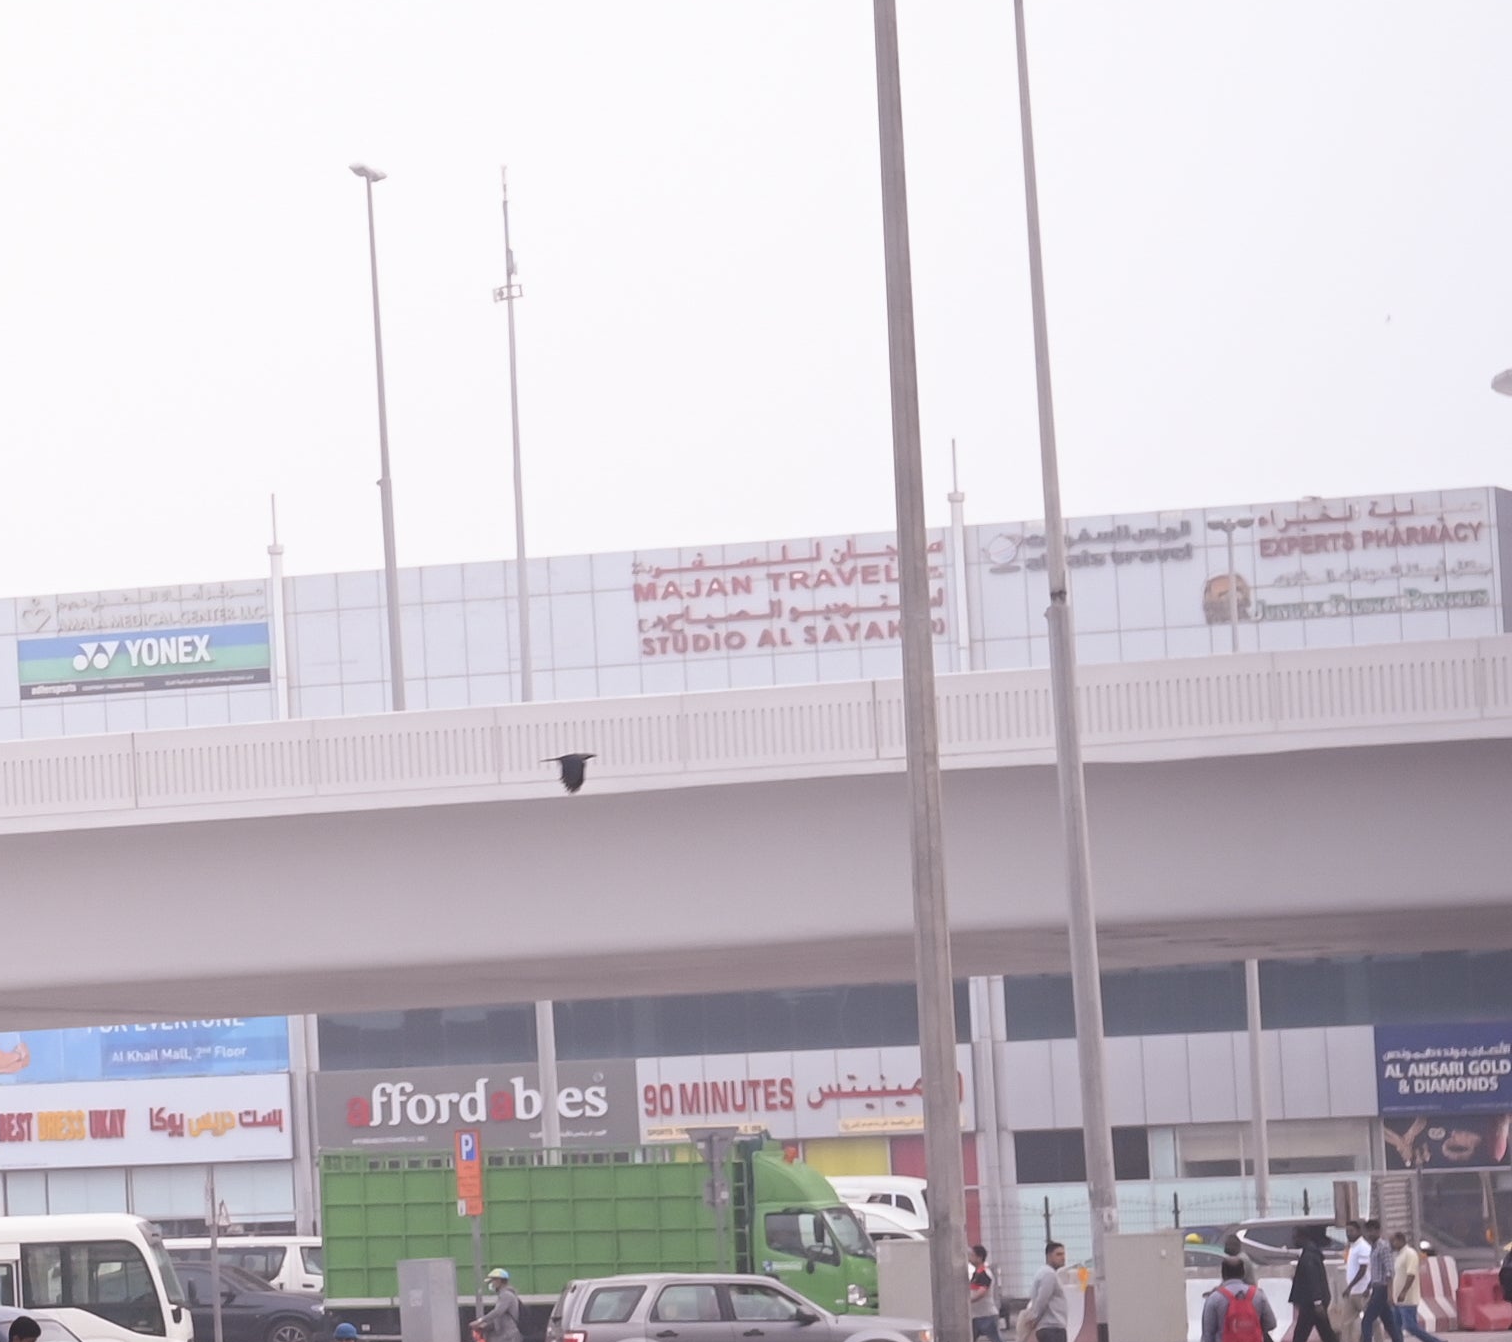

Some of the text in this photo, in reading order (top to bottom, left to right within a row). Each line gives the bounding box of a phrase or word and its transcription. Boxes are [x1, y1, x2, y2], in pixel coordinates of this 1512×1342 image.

[1260, 521, 1482, 559] EXPERTS PHARMACY
[634, 574, 753, 603] MAJAN
[111, 611, 178, 630] MEDICAL
[180, 607, 237, 626] CENTER
[125, 634, 212, 667] YONEX
[642, 630, 747, 657] STUDIO
[757, 627, 792, 648] AL
[126, 1048, 158, 1064] Khail
[213, 1044, 248, 1059] Floor
[1384, 1058, 1512, 1079] AL ANSARI GOLD
[643, 1076, 795, 1118] 90 MINUTES
[1398, 1075, 1499, 1095] & DIAMONDS
[346, 1076, 609, 1128] affordabes
[37, 1109, 86, 1142] DRESS
[88, 1108, 127, 1140] UKAY
[461, 1134, 474, 1160] P
